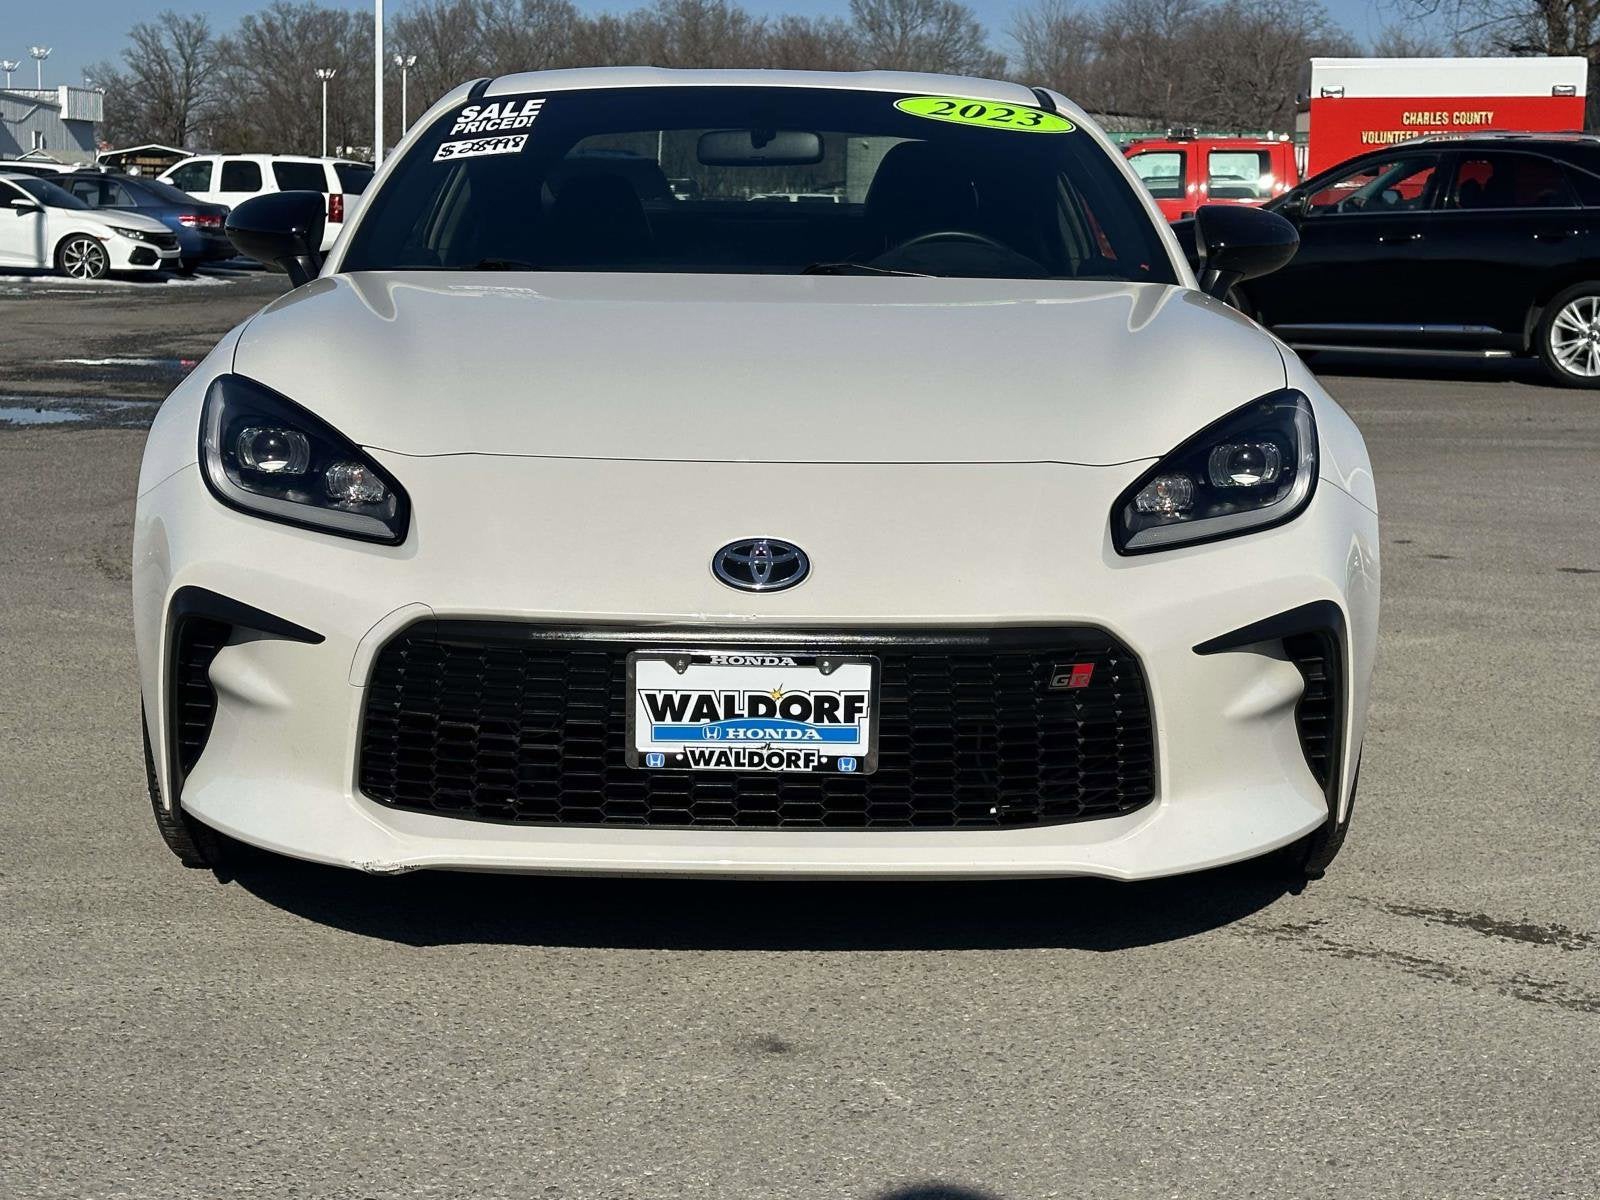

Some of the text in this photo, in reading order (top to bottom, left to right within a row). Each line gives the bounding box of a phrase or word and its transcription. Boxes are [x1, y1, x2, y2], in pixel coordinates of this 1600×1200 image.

[456, 99, 546, 123] SALE
[927, 101, 1045, 127] 2023
[1402, 111, 1493, 125] CHARLES COUNTY
[450, 116, 536, 135] PRICED!
[709, 655, 797, 666] HONDA
[1052, 673, 1089, 687] GR
[642, 692, 867, 725] WALDORF
[725, 728, 822, 740] HONDA
[686, 749, 818, 770] WALDORF
